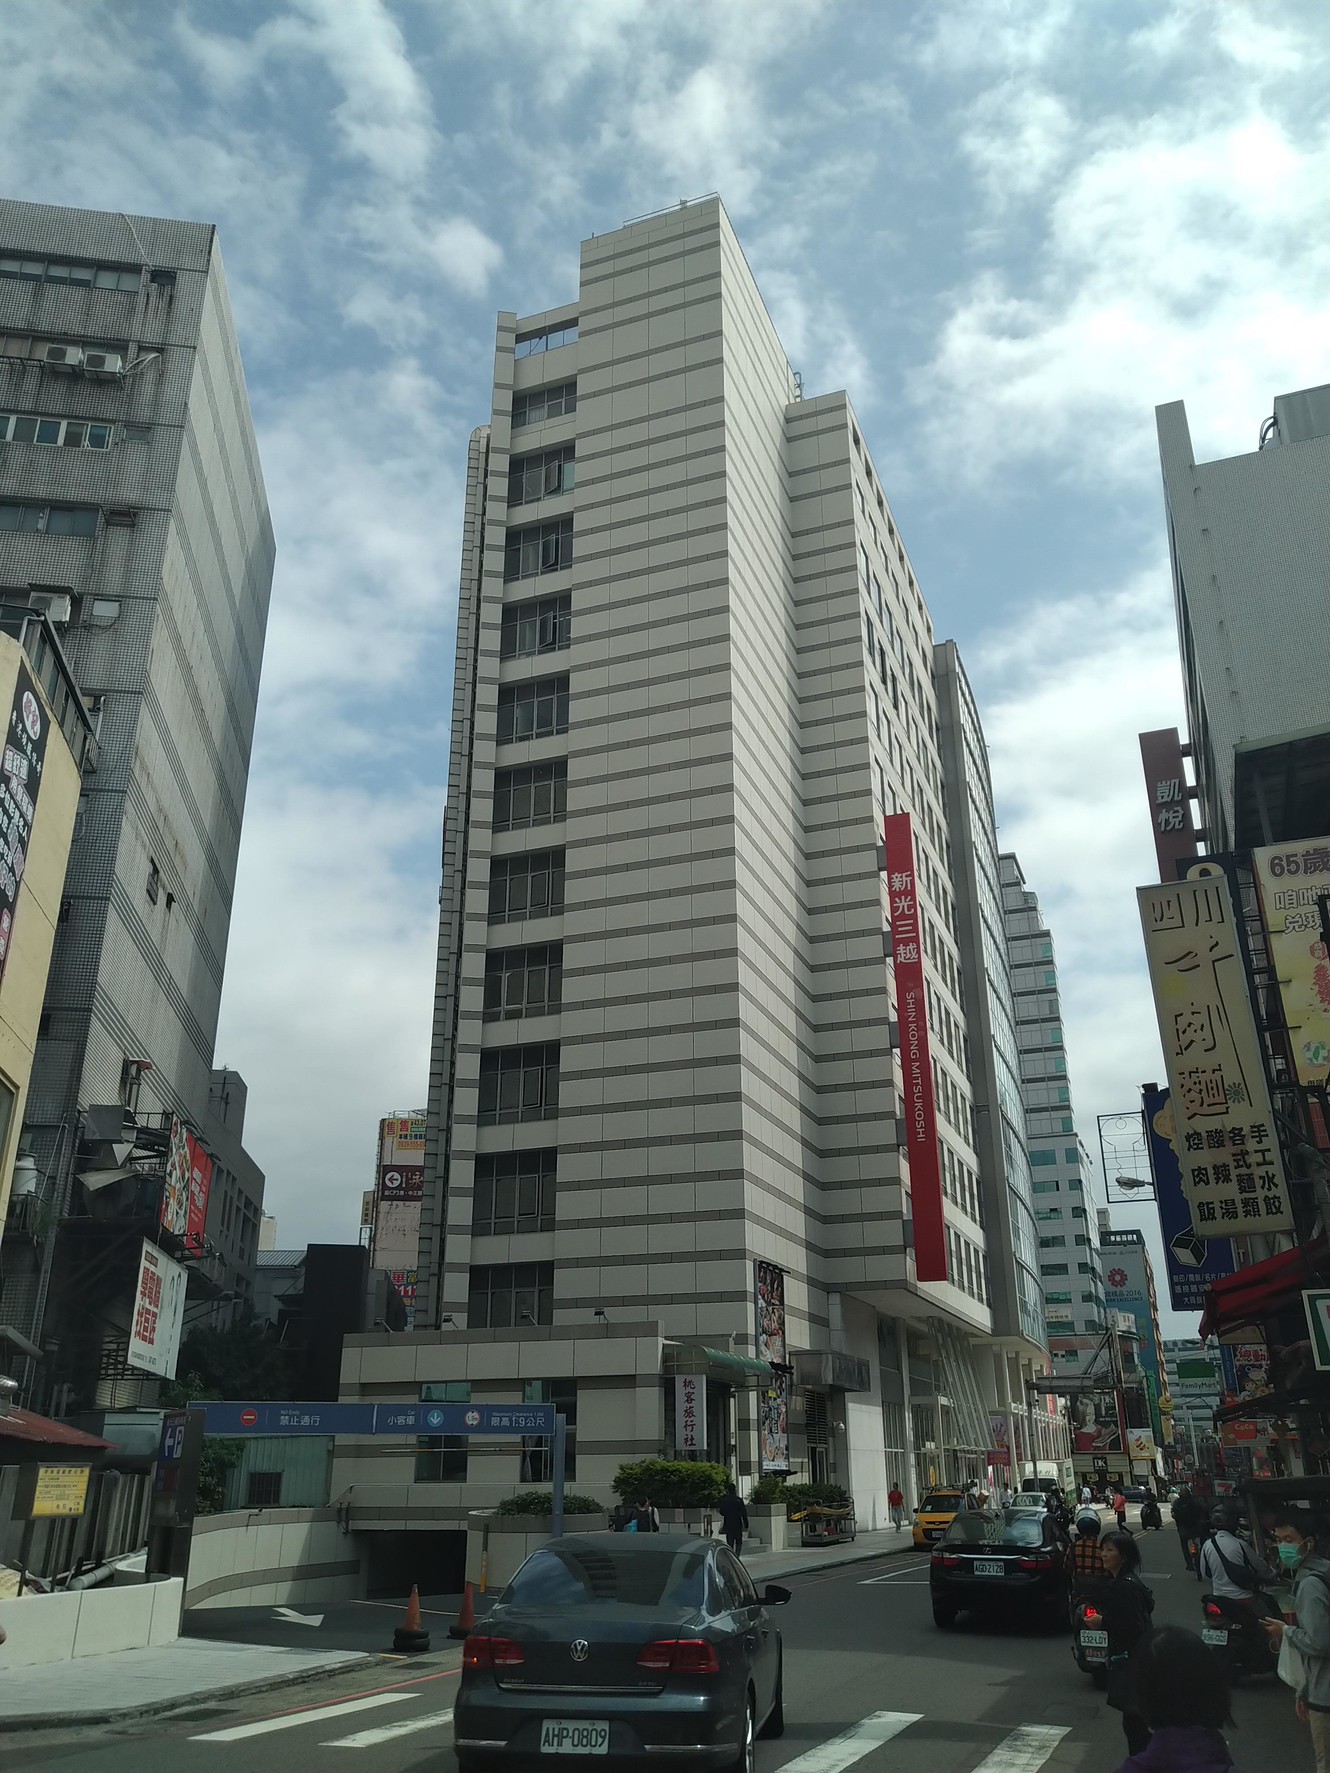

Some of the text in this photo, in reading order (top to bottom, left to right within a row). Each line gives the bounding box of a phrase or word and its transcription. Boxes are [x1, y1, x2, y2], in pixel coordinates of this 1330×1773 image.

[1156, 778, 1184, 832] 凱悅
[891, 871, 918, 964] 新光三越
[1151, 886, 1225, 932] 四川
[905, 991, 926, 1142] SHIN KONG MITSUKOSHI
[1205, 1128, 1239, 1220] 酸辣湯
[1228, 1127, 1261, 1219] 各式麵類
[1250, 1123, 1283, 1216] 手工水餃
[1126, 1289, 1142, 1297] 2016
[1181, 1381, 1216, 1390] FamilyMart
[280, 1415, 320, 1426] 禁止通行
[387, 1415, 415, 1426] 小客車
[682, 1377, 696, 1447] 桃客旅行社
[1234, 1423, 1254, 1431] CoCo
[542, 1727, 607, 1749] AHP-0809
